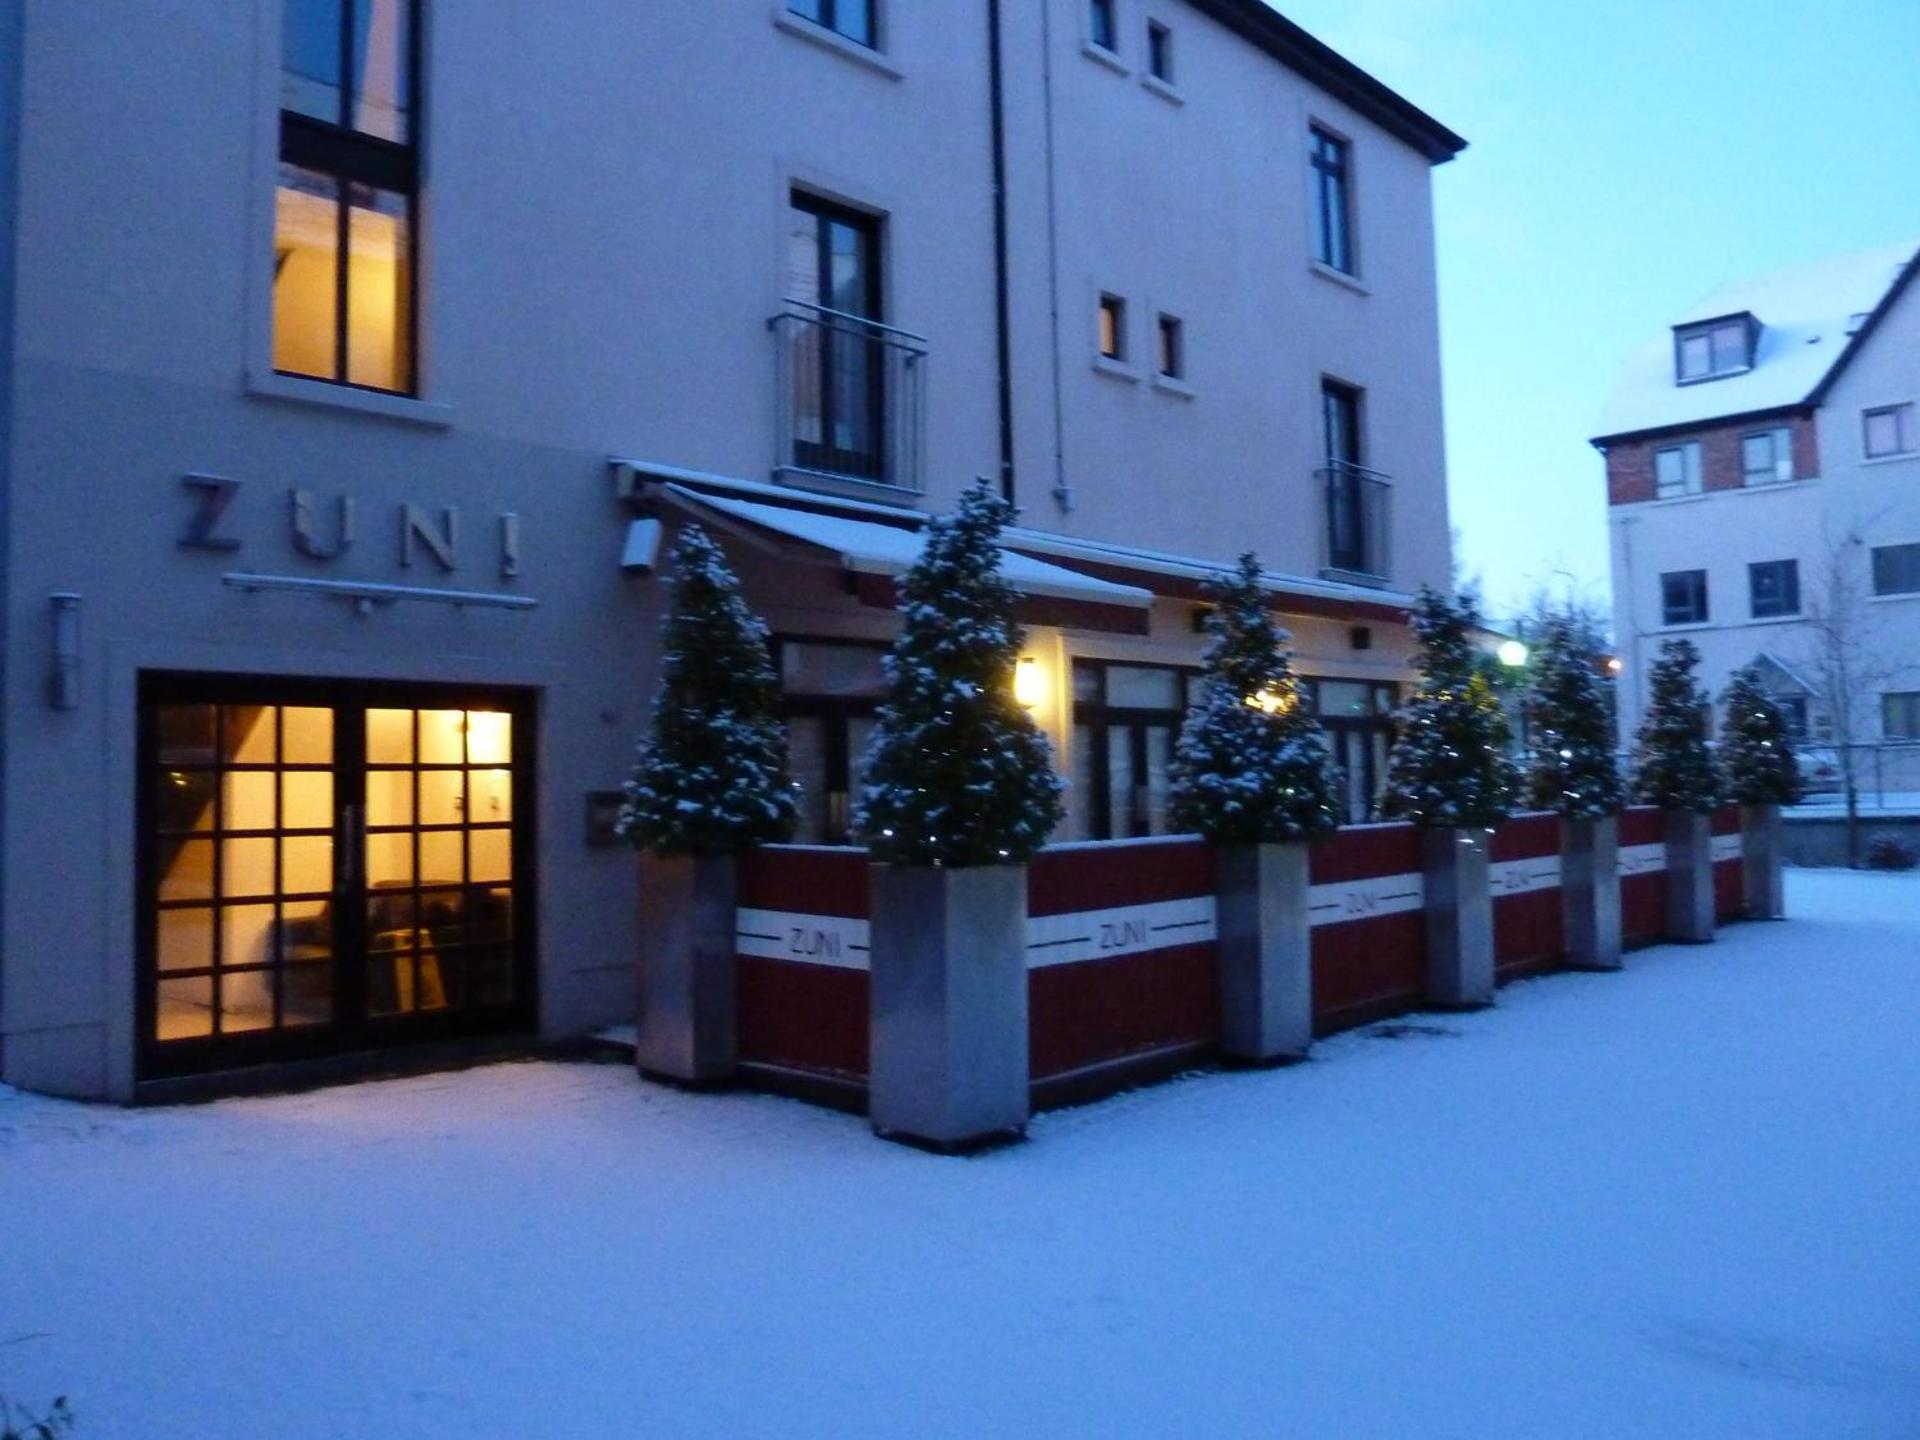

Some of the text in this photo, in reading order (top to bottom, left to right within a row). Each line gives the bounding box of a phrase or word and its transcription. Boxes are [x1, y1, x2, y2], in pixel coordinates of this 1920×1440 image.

[175, 471, 519, 578] ZUNI
[791, 927, 841, 957] ZUNI
[1100, 920, 1146, 949] ZUNI
